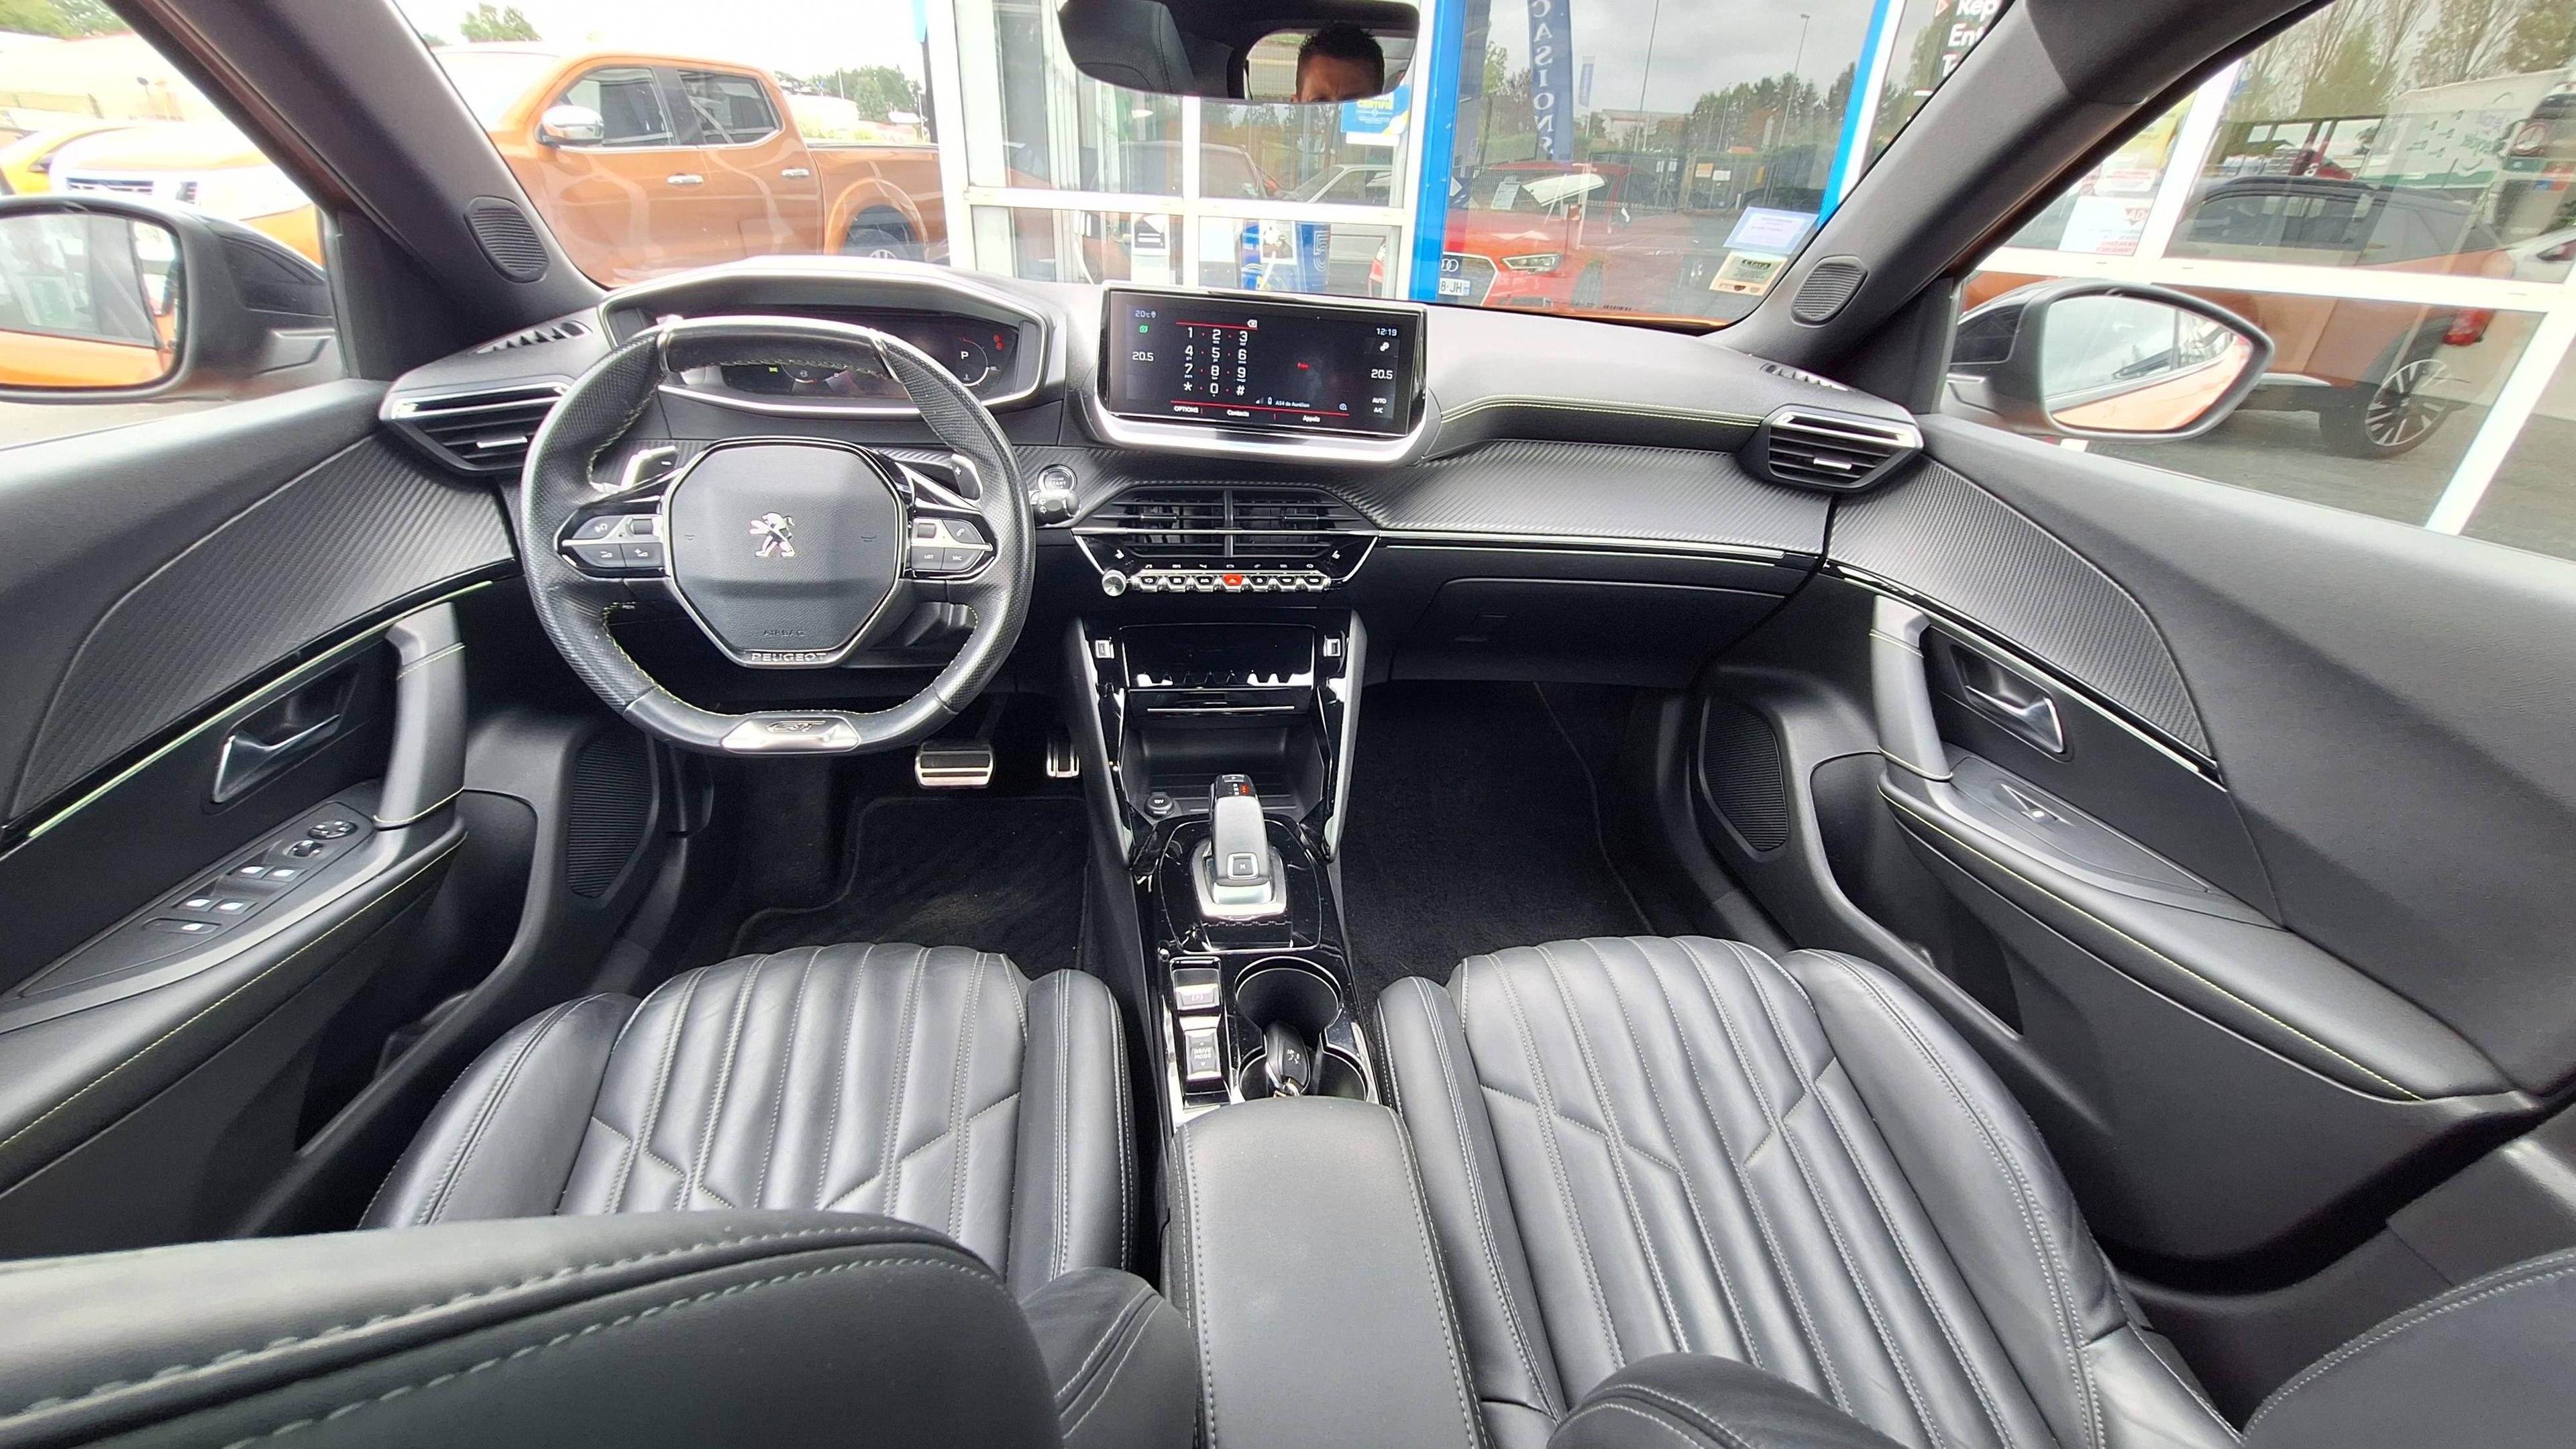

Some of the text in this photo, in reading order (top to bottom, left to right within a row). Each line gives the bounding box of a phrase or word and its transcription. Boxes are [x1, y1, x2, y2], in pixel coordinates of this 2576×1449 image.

[1187, 327, 1248, 342] 1 2 3
[1376, 327, 1397, 336] 12:19
[961, 351, 969, 360] P
[1132, 352, 1155, 362] 20.5
[1185, 345, 1247, 360] 4 5 6
[1184, 363, 1246, 378] 7 8 9
[1371, 368, 1393, 380] 20.5
[1210, 382, 1219, 394] 0
[751, 653, 826, 661] PEUGEOT
